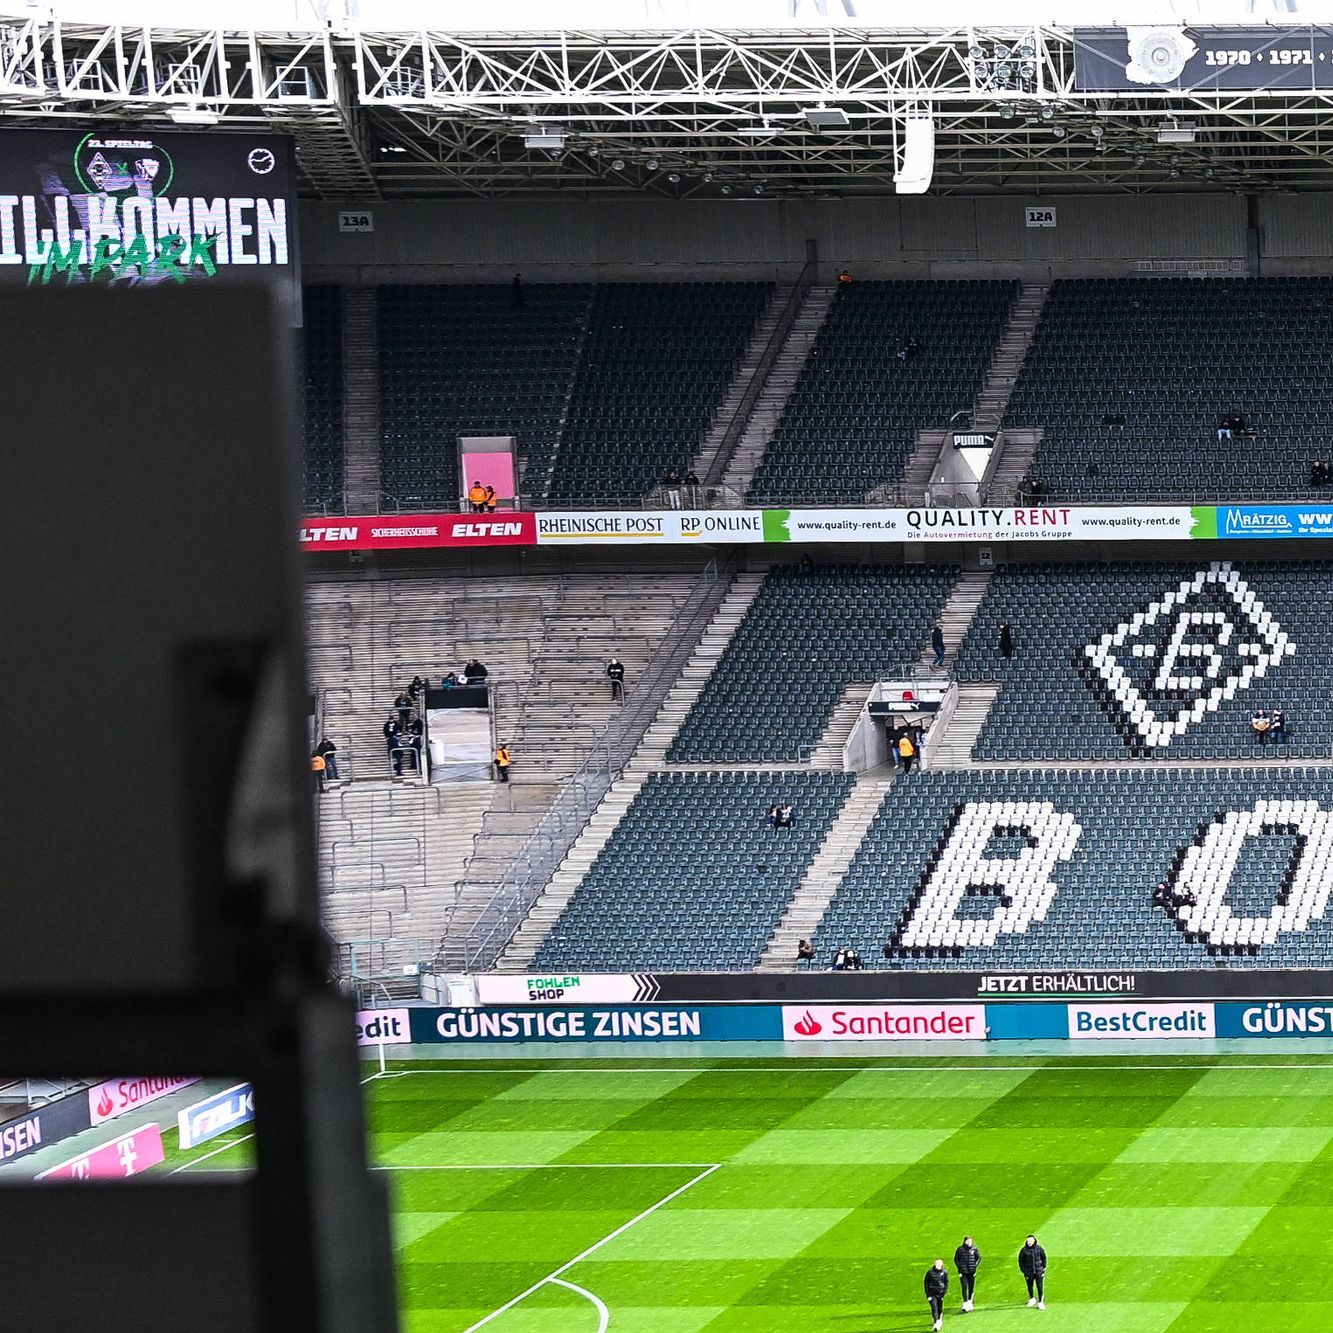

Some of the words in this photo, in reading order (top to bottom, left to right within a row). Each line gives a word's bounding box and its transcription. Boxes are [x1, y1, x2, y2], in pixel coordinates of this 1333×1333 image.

[1205, 49, 1251, 66] 1970
[1269, 48, 1314, 66] 1971
[343, 215, 370, 228] 13A
[1029, 211, 1053, 222] 12A
[0, 195, 289, 265] ILLKOMMEN
[953, 435, 985, 446] PUMA
[539, 516, 622, 533] RHEINISCHE
[625, 516, 664, 532] POST
[681, 516, 701, 532] RP
[704, 516, 761, 532] ONLINE
[797, 519, 897, 533] www.quality-rent.de
[906, 509, 1071, 530] QUALITY.RENT
[1081, 515, 1181, 529] www.quality-rent.de
[300, 527, 358, 542] LTEN
[451, 522, 523, 538] ELTEN
[907, 531, 921, 539] Die
[924, 531, 993, 539] Autovermietung
[1012, 530, 1039, 539] Jacobs
[1041, 530, 1073, 539] Gruppe
[527, 976, 580, 990] FOHLEN
[977, 976, 1028, 992] JETZT
[1033, 974, 1136, 992] ERHÄLTLICH!
[529, 989, 565, 1001] SHOP
[437, 1008, 585, 1037] GÜNSTIGE
[593, 1011, 701, 1037] ZINSEN
[832, 1011, 975, 1035] Santander
[1077, 1008, 1207, 1032] BestCredit
